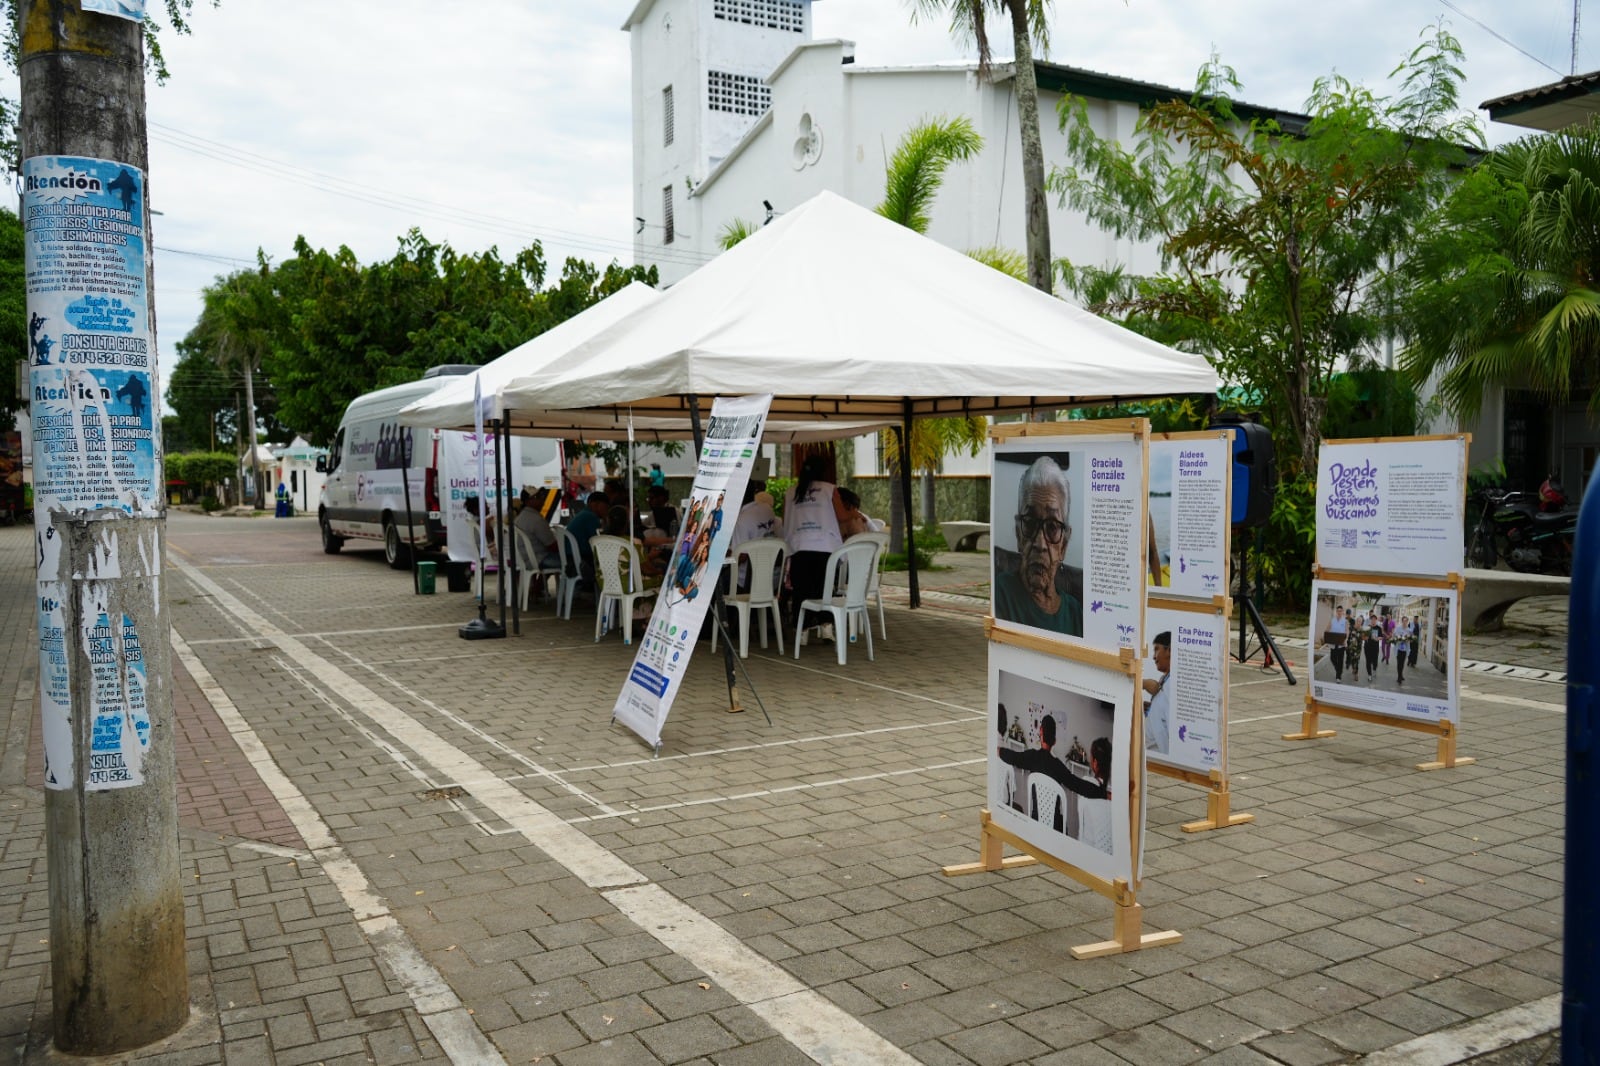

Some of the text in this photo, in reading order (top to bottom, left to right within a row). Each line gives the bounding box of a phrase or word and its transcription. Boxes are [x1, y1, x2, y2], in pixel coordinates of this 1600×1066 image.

[27, 172, 100, 191] Atención
[64, 202, 108, 218] JURÍDICA
[110, 209, 132, 222] PARA
[56, 217, 91, 231] RASOS,
[92, 219, 142, 237] LESIONADOS
[56, 230, 128, 246] LEISHMANIASIS
[93, 247, 119, 255] regular,
[101, 255, 126, 263] soldado
[64, 270, 90, 278] regular
[85, 285, 109, 294] (desde
[62, 334, 148, 354] CONSULTA GRATIS
[70, 351, 148, 368] 314 528 6235
[35, 383, 111, 400] Atenin
[119, 415, 142, 427] PARA
[66, 440, 137, 453] LEHMAIASIS
[472, 449, 496, 457] UPD
[1091, 457, 1123, 468] Graciela
[1179, 459, 1208, 468] Blandón
[1091, 469, 1125, 480] González
[1179, 468, 1202, 477] Torres
[1329, 458, 1378, 486] Donde
[1091, 481, 1120, 492] Herrera
[1338, 474, 1378, 492] estén,
[1325, 504, 1377, 520] buscando
[1178, 626, 1214, 638] Ena Pérez
[1178, 635, 1212, 647] Loperena
[91, 771, 108, 783] 14
